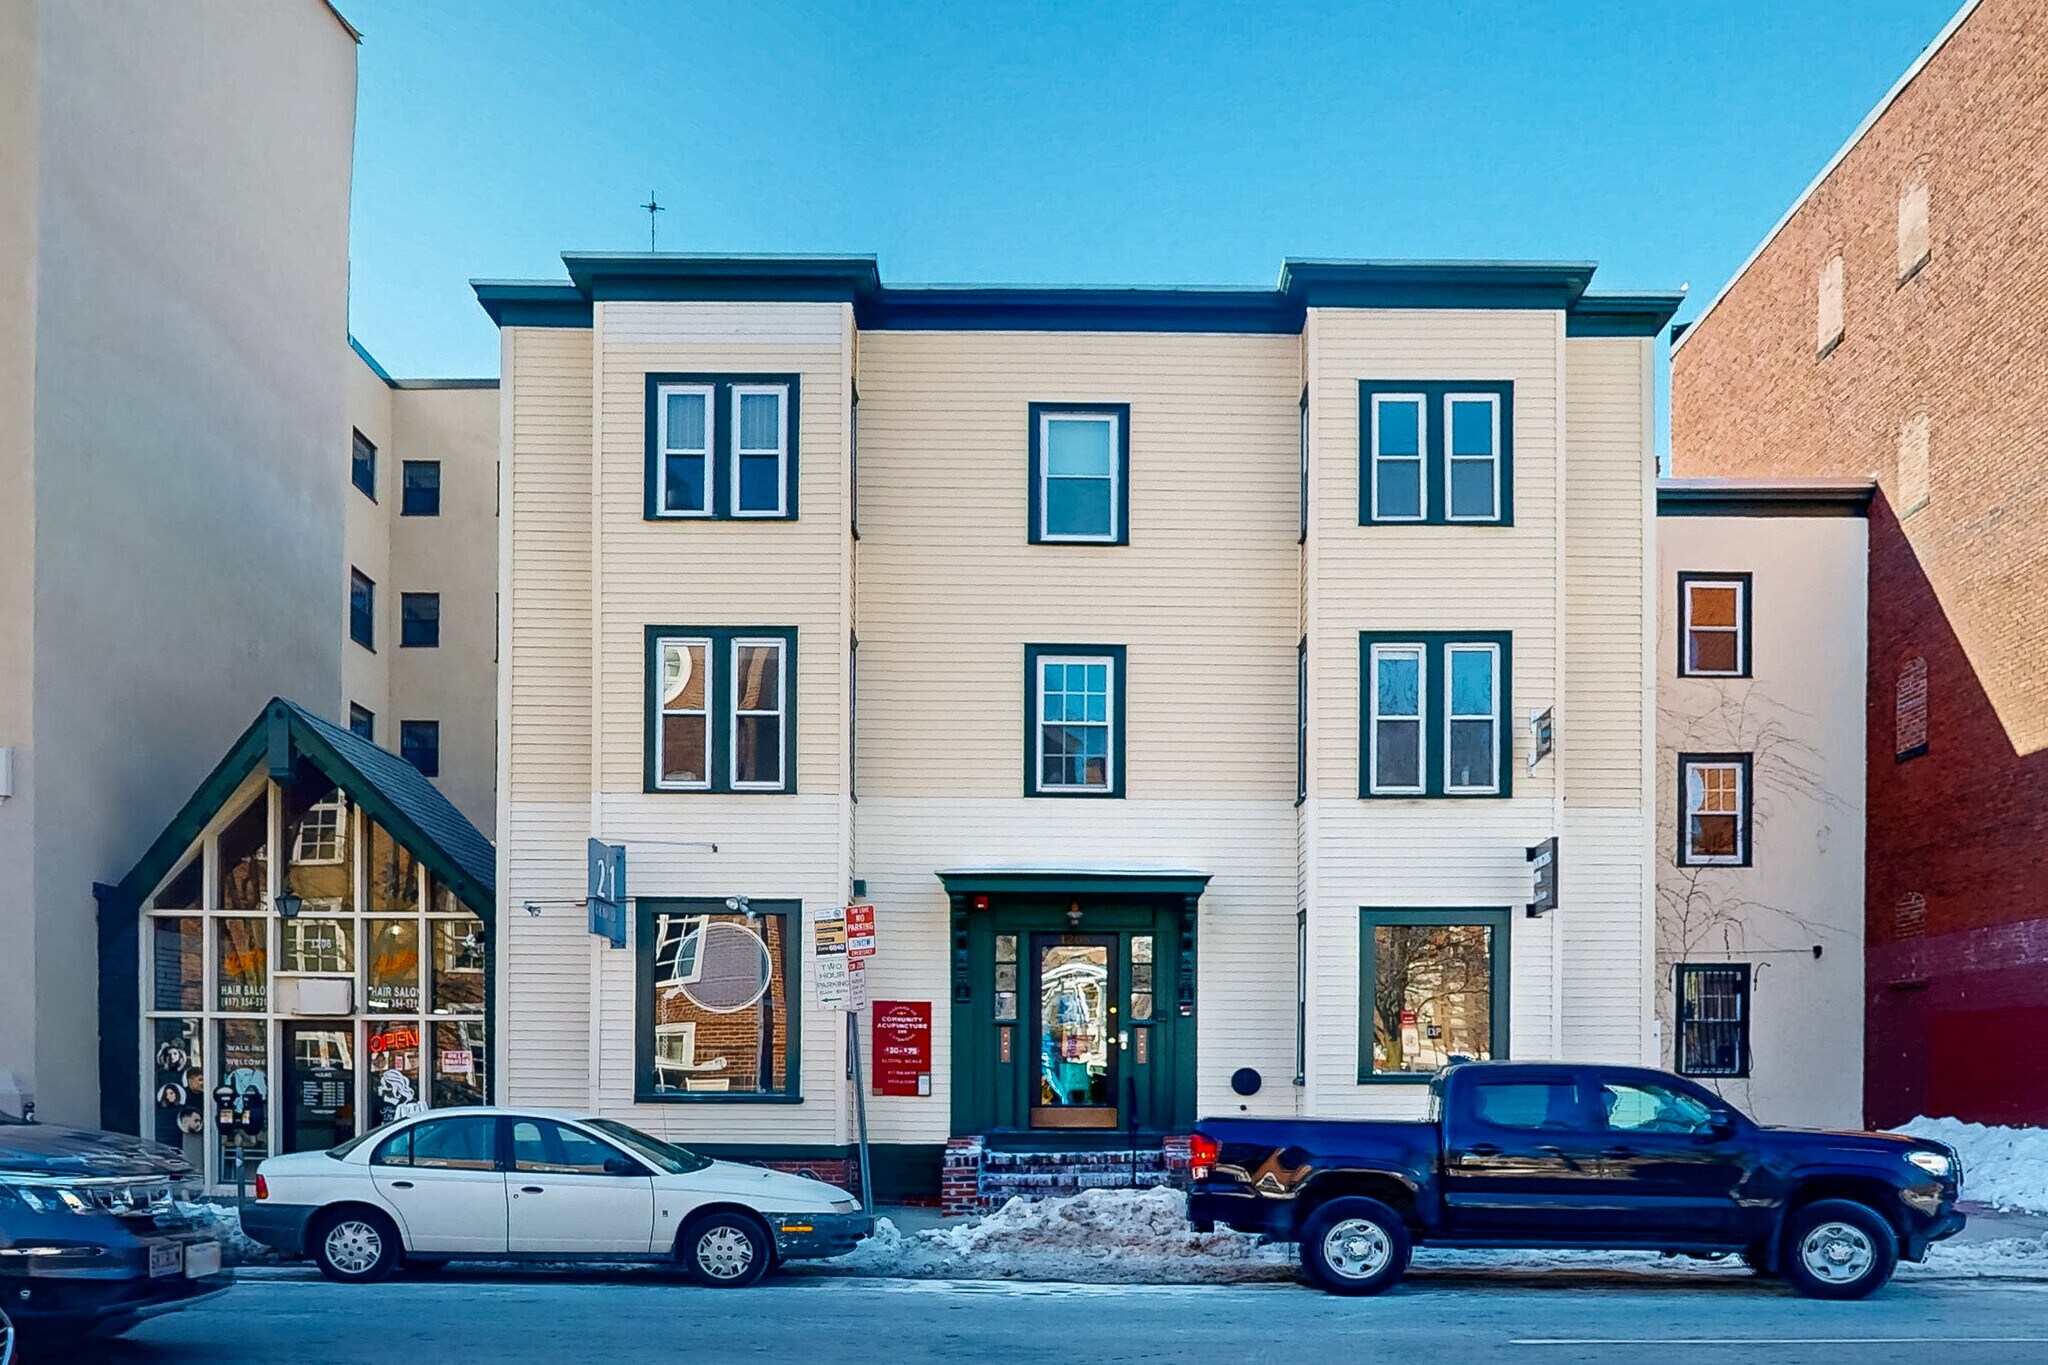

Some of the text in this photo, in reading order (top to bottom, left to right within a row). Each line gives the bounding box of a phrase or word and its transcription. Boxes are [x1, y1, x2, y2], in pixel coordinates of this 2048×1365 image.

[597, 859, 615, 902] 21
[847, 922, 873, 932] PARKING
[819, 971, 845, 979] HOUR
[816, 980, 850, 989] PARKING
[221, 985, 267, 996] HAIR SALO
[371, 987, 392, 997] HAIR
[370, 1028, 418, 1052] OPEN
[226, 1058, 266, 1066] WELCOME
